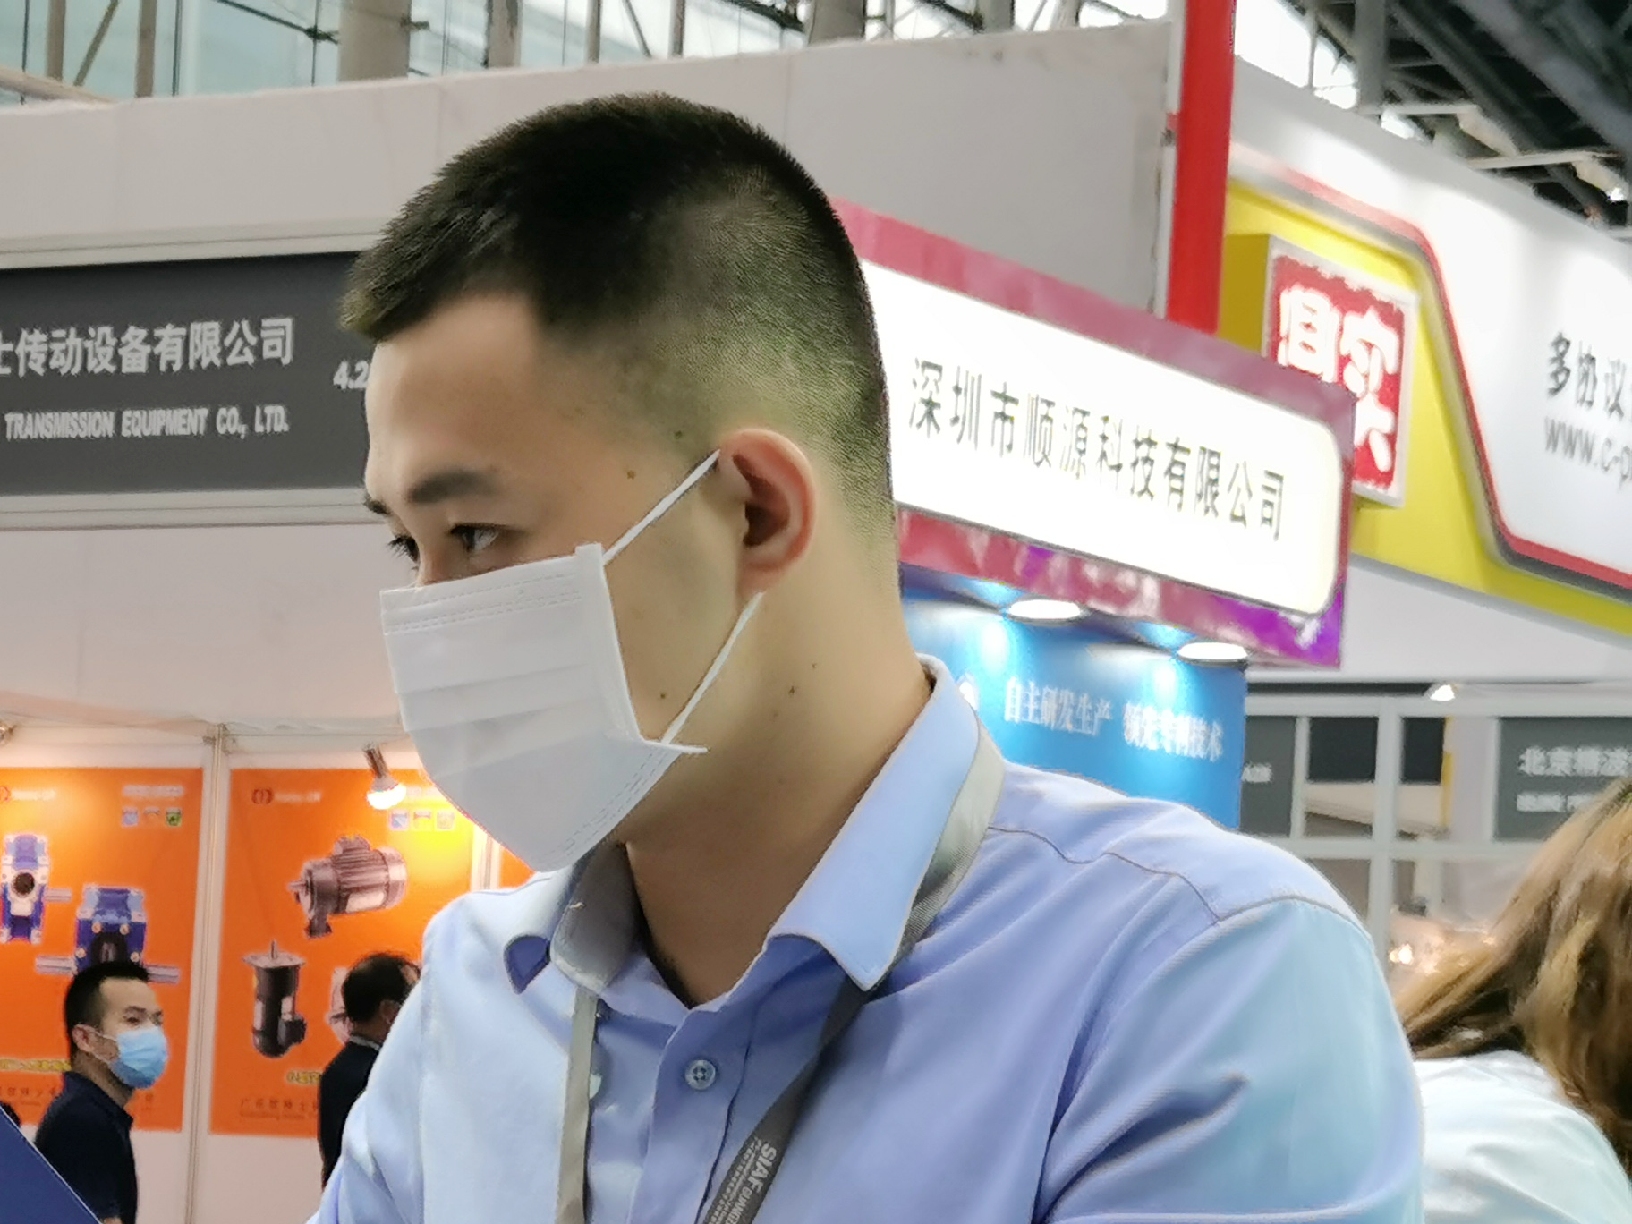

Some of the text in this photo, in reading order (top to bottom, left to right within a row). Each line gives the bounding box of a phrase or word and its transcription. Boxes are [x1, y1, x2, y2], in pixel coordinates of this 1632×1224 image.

[4, 410, 115, 440] TRANSMISSION
[121, 406, 209, 439] EQUIPMENT
[254, 402, 290, 433] LTD.
[909, 356, 1285, 542] 深圳市顺源科技有限公司
[1004, 676, 1112, 737] 自主研发生产
[747, 1142, 778, 1194] SIAF
